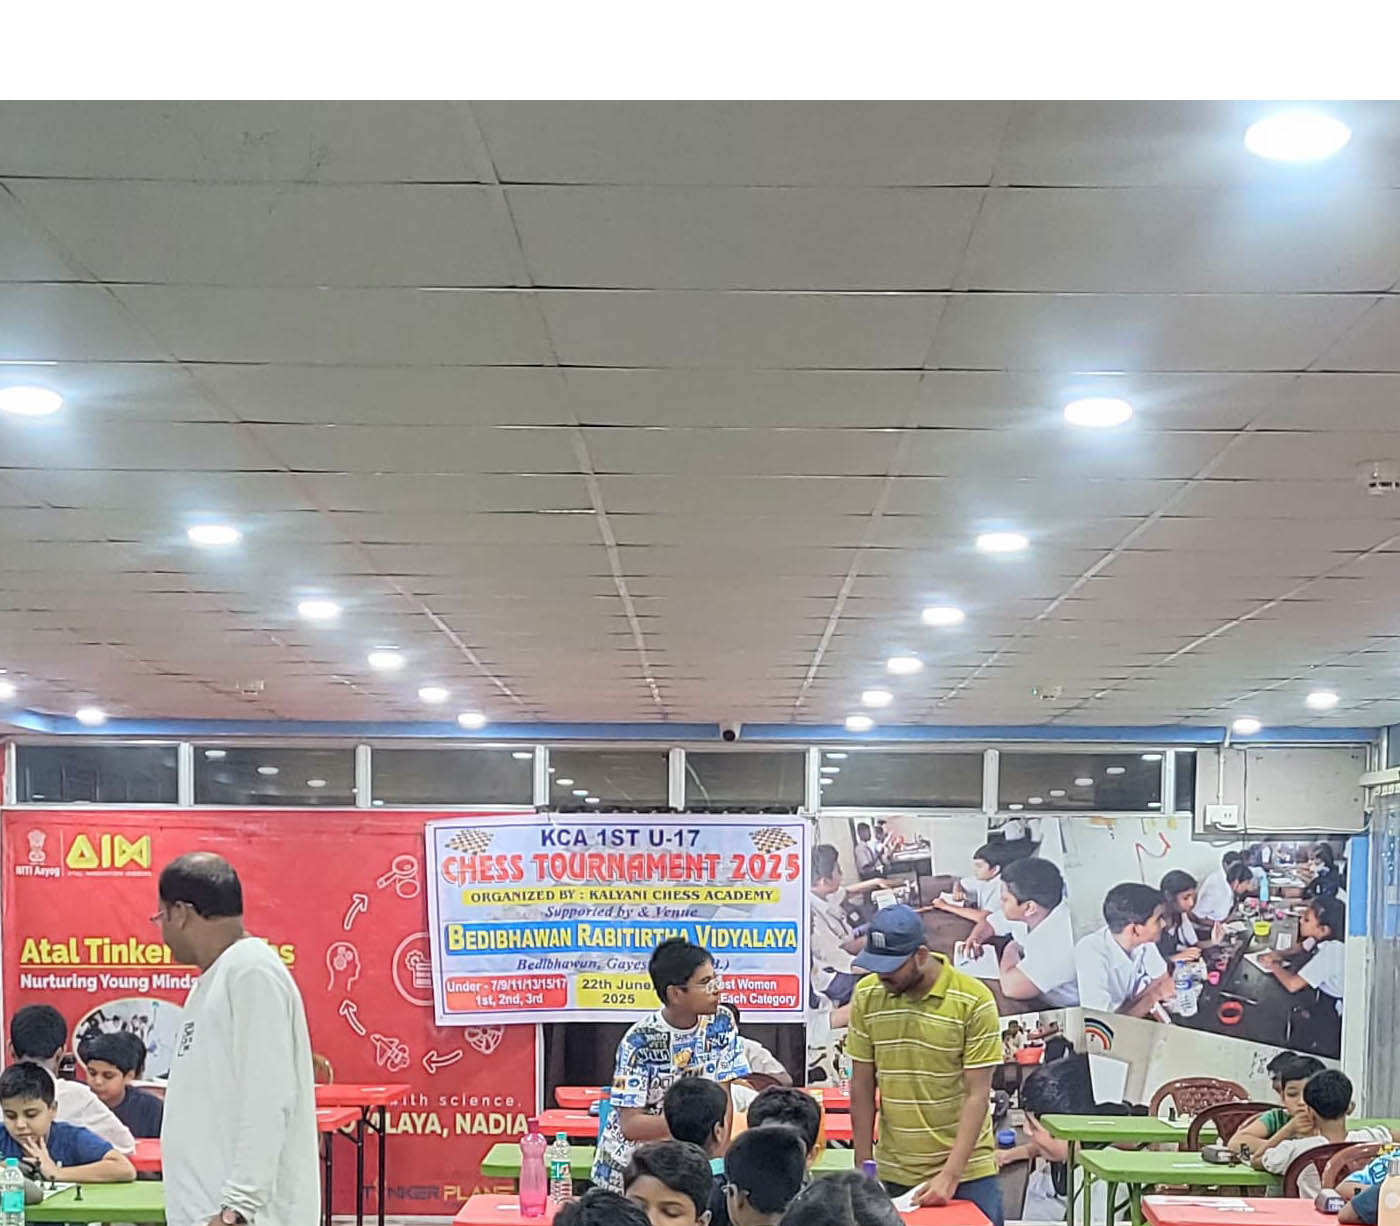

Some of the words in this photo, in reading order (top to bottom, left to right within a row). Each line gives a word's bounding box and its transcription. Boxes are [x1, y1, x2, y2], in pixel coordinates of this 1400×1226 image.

[541, 829, 588, 847] KCA
[596, 829, 640, 847] 1ST
[649, 829, 701, 847] U-17
[442, 853, 525, 887] CHESS
[530, 852, 721, 885] TOURNAMENT
[729, 852, 801, 883] 2025
[471, 890, 556, 903] ORGANIZED
[559, 890, 575, 900] BY
[589, 890, 648, 901] KALYANI
[652, 889, 701, 901] CHESS
[704, 890, 774, 901] ACADEMY
[545, 906, 610, 920] Supported
[617, 905, 632, 920] by
[638, 907, 650, 918] &
[655, 906, 700, 918] Venue
[447, 923, 572, 951] BEDIBHAWAN
[695, 924, 798, 949] VIDYALAYA
[20, 937, 80, 964] Atal
[606, 957, 648, 971] Gayes
[20, 974, 98, 991] Nurturing
[100, 975, 150, 992] Young
[447, 981, 481, 993] Under
[491, 979, 567, 991] 7/9/11/13/15/17
[582, 979, 612, 990] 22th
[476, 995, 497, 1007] 1st,
[499, 993, 524, 1006] 2nd,
[526, 992, 543, 1004] 3rd
[602, 993, 636, 1005] 2025
[721, 993, 747, 1004] Each
[749, 993, 797, 1007] Category
[439, 1094, 522, 1107] science.
[455, 1112, 530, 1135] NADIA
